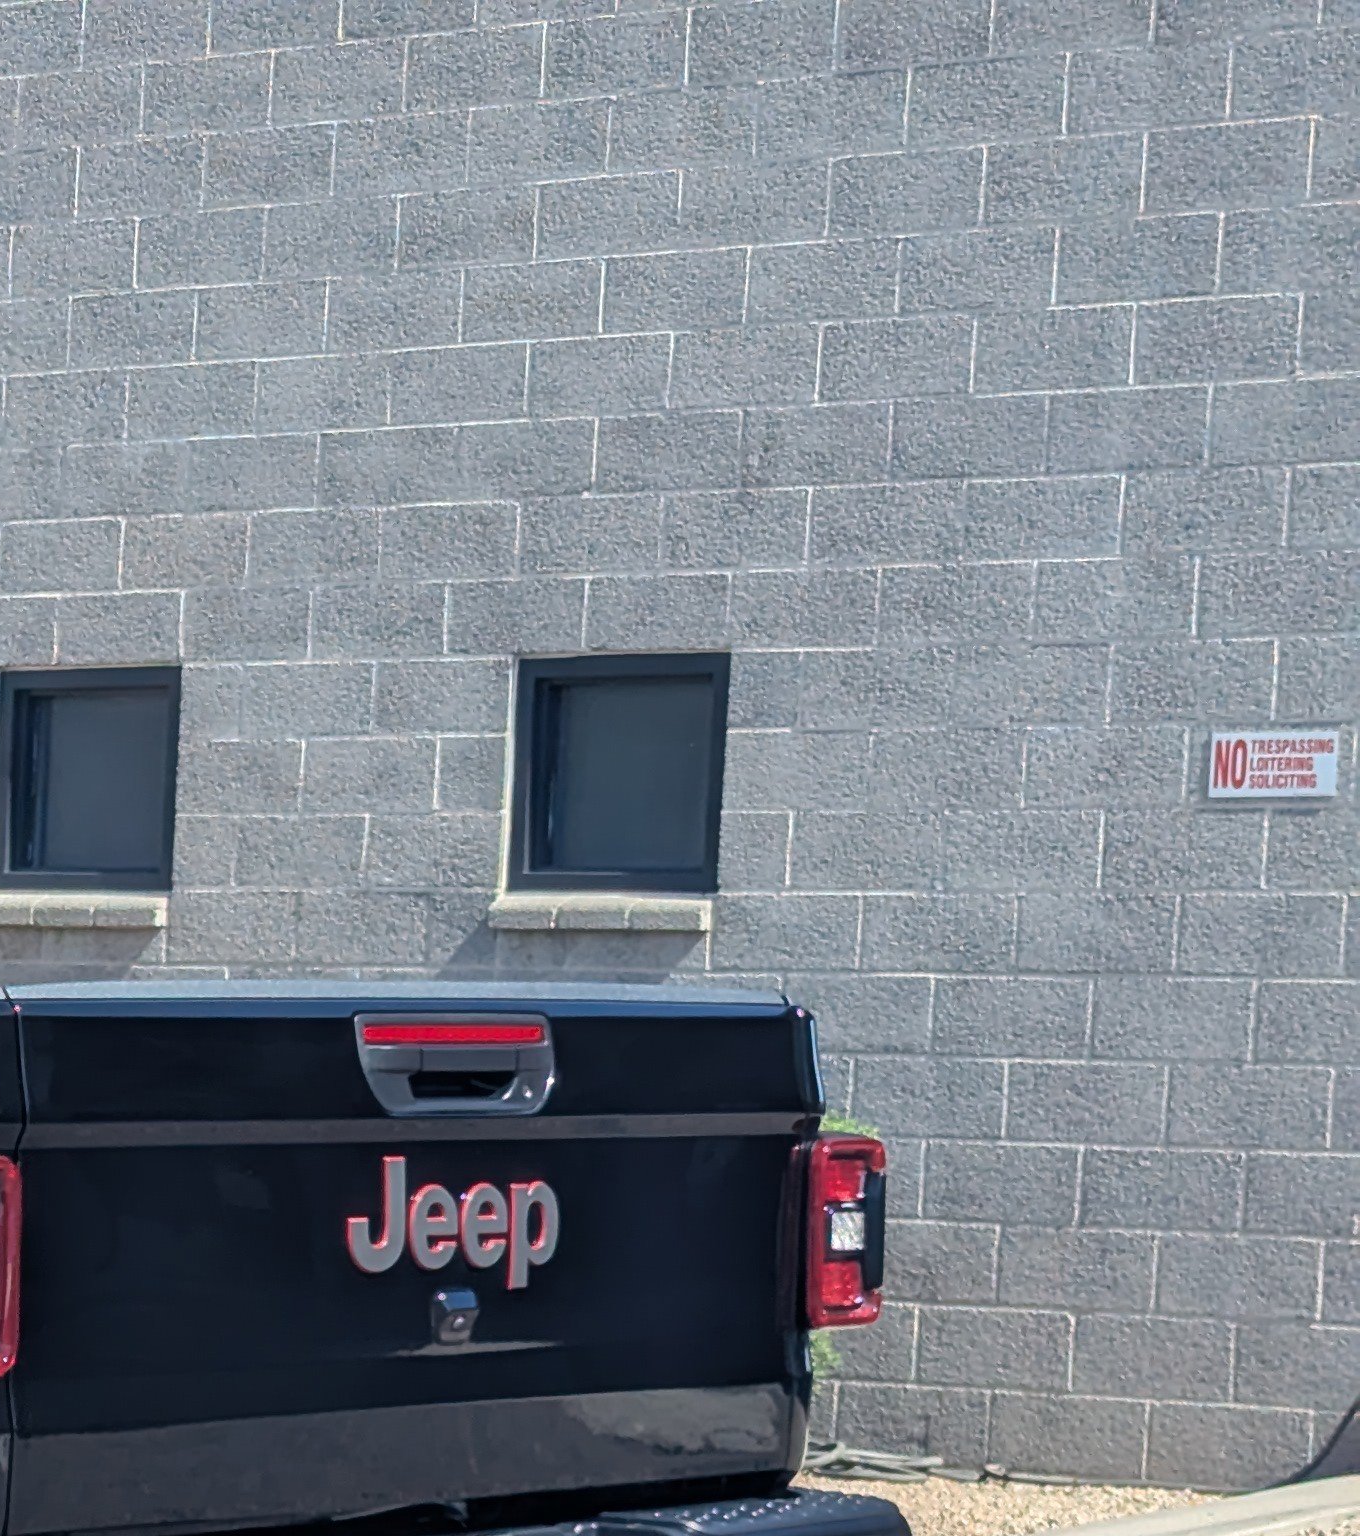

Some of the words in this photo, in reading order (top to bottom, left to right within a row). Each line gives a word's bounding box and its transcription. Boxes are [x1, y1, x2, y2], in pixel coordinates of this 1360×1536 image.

[1251, 738, 1335, 754] TRESPASSING
[1213, 739, 1248, 789] NO
[1250, 756, 1314, 772] LOITERING
[1249, 773, 1317, 789] SOLICITING
[345, 1155, 561, 1291] Jeep
